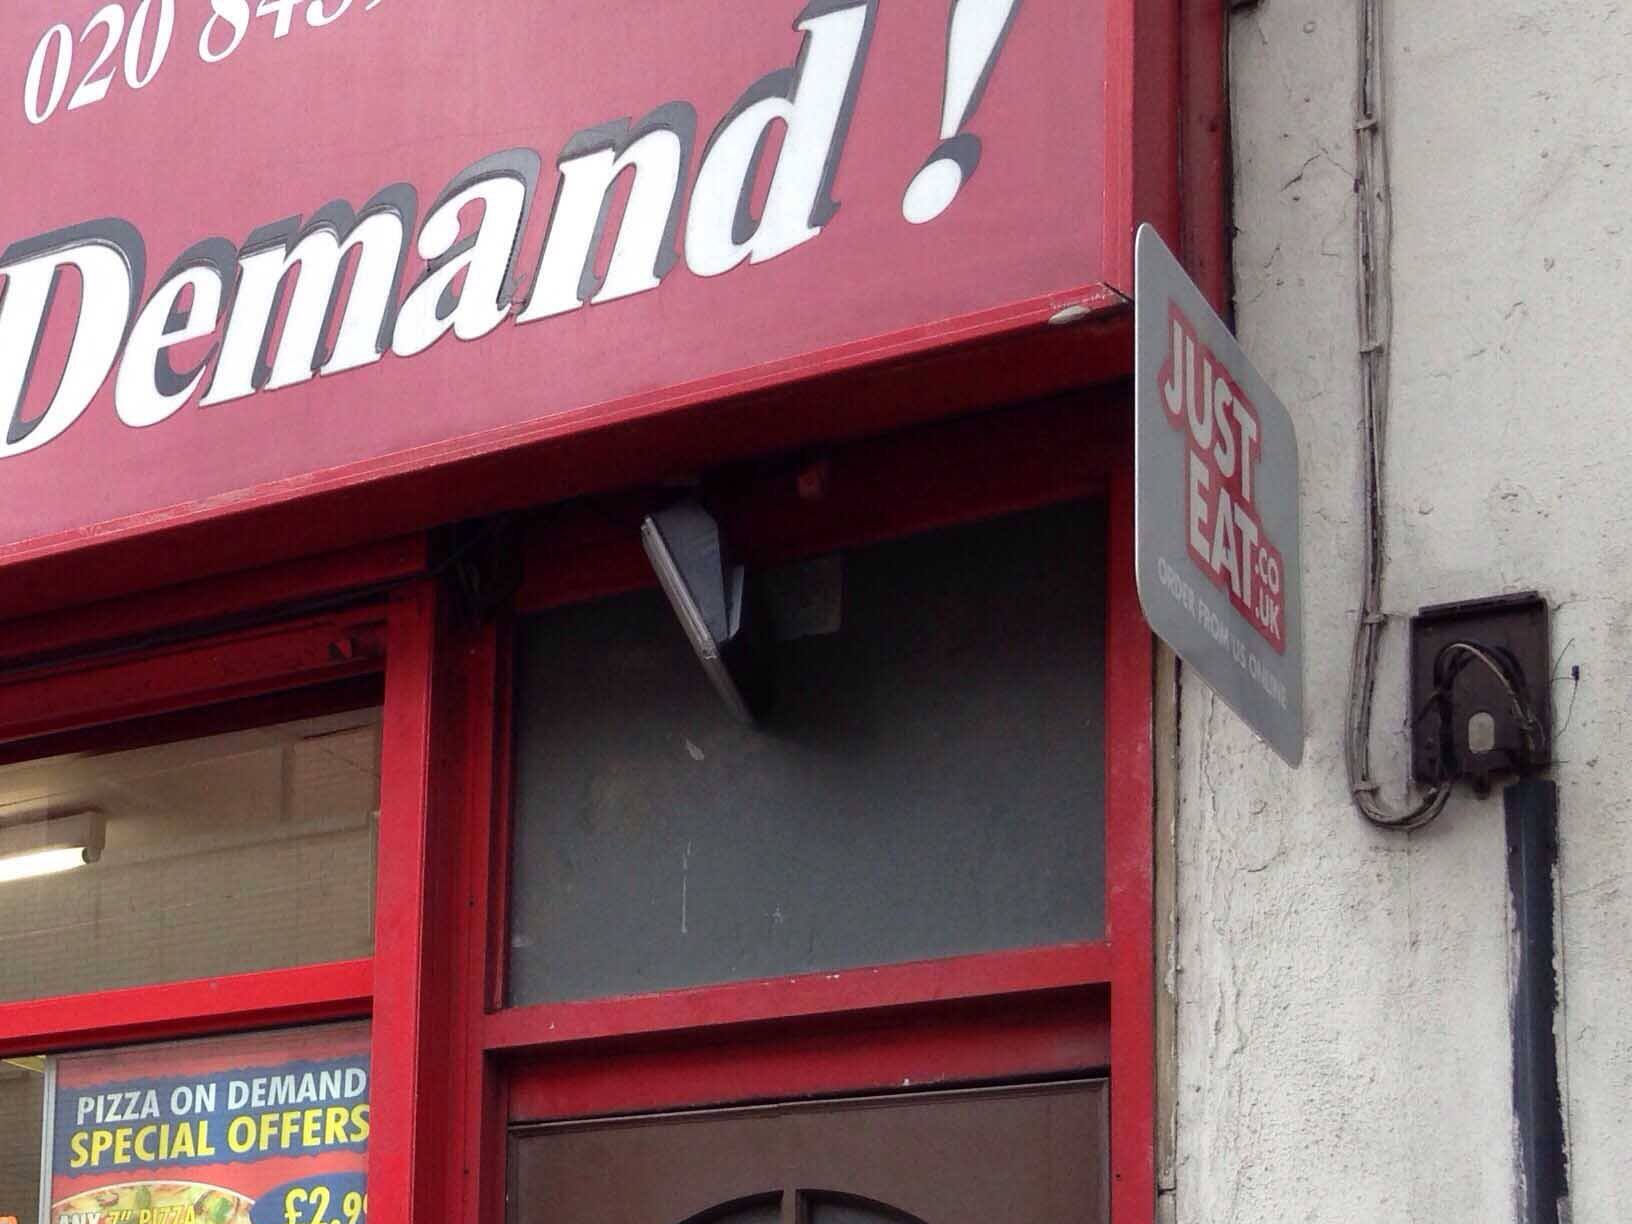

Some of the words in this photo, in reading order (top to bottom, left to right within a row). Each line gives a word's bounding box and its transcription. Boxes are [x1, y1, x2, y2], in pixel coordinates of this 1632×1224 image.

[24, 0, 175, 124] 020
[1164, 319, 1257, 503] JUST
[1188, 450, 1260, 610] EAT
[70, 1120, 216, 1169] SPECIAL
[227, 1103, 370, 1154] OFFERS
[76, 1089, 161, 1126] PIZZA
[170, 1083, 217, 1117] ON
[227, 1067, 368, 1111] DEMAND
